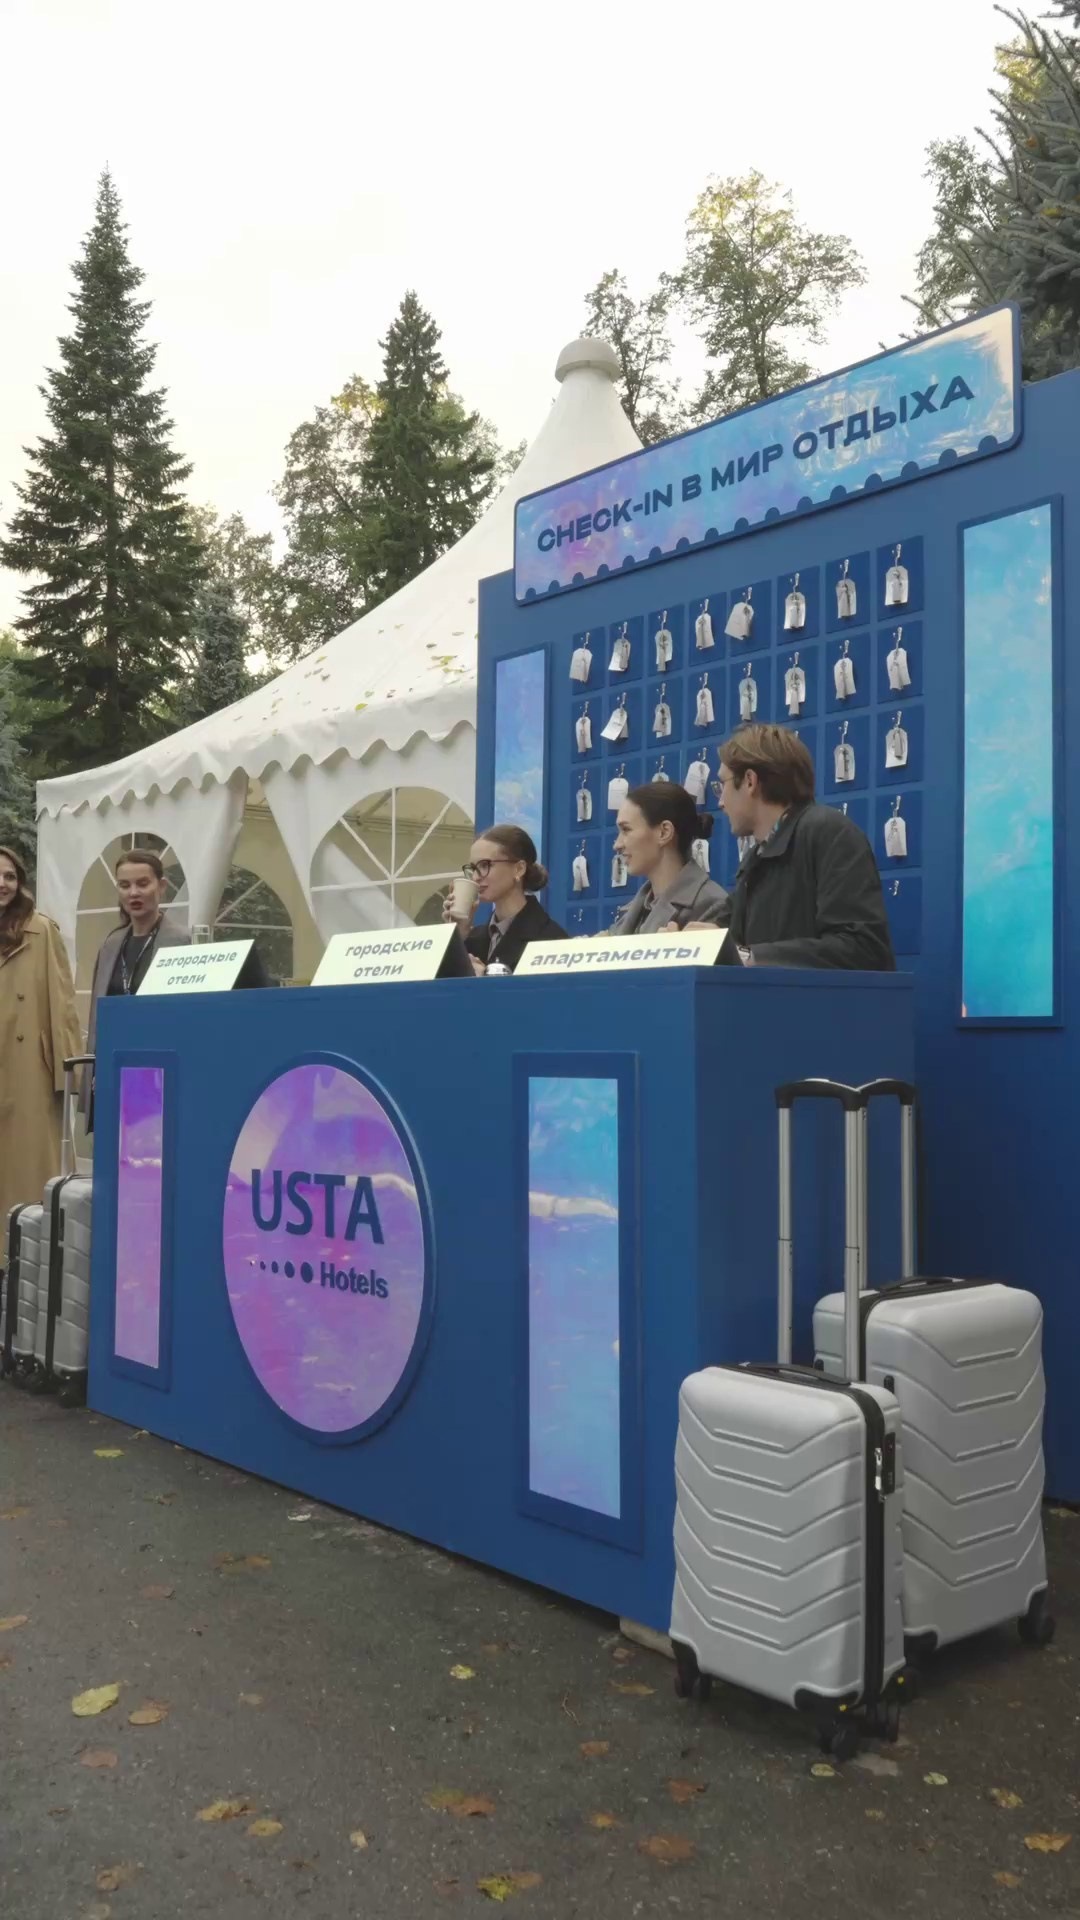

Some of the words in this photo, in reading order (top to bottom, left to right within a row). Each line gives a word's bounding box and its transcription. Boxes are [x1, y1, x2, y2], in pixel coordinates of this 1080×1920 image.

[537, 484, 672, 552] CHECK-IN
[682, 473, 702, 502] В
[711, 443, 784, 492] МИР
[792, 375, 975, 460] ОТДЫХА
[156, 951, 238, 968] загородные
[345, 939, 434, 959] городские
[530, 946, 701, 968] апартаменты
[167, 973, 207, 986] отели
[353, 964, 404, 978] отели
[251, 1168, 385, 1245] USTA
[320, 1261, 389, 1299] Hotels
